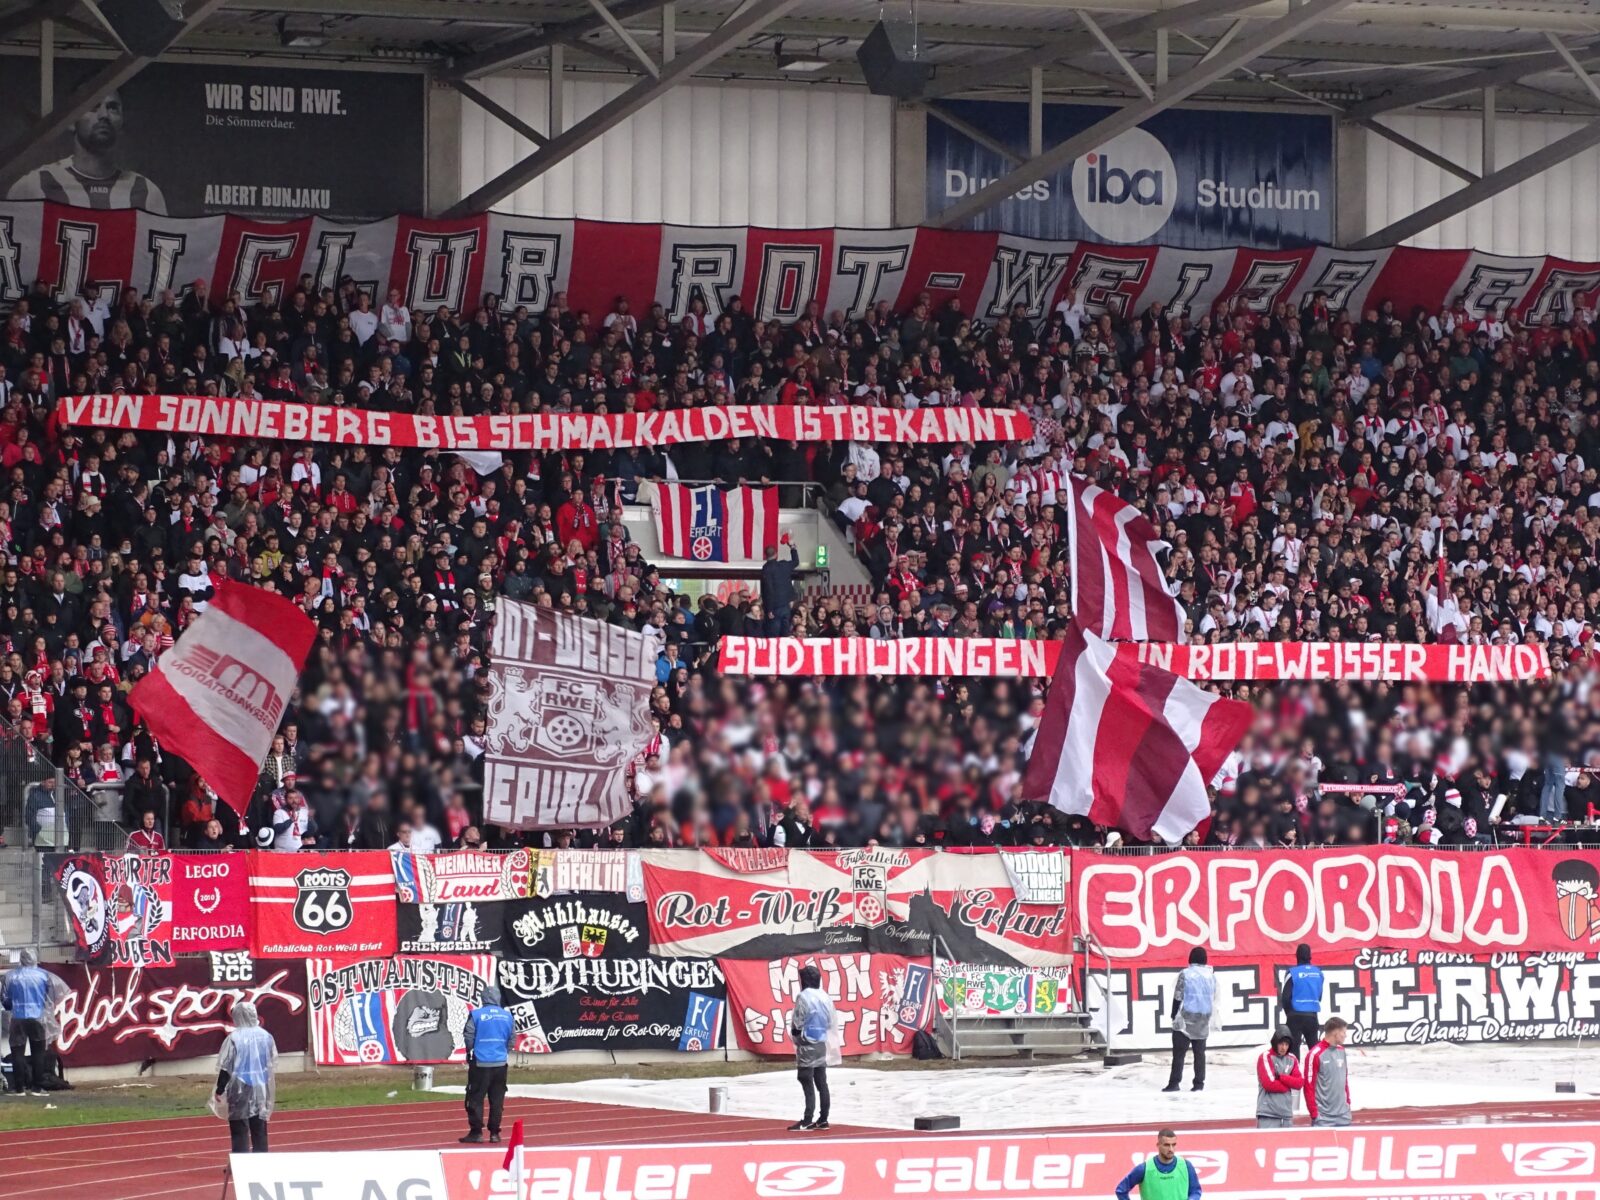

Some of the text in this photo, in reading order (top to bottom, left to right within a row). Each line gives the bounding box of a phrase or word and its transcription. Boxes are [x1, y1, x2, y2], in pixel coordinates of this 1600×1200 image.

[205, 83, 347, 115] WIR SIND RWE.
[205, 114, 296, 130] Die Sömmerdaer.
[1088, 152, 1163, 206] iba
[1198, 178, 1320, 211] Studium
[205, 184, 331, 210] ALBERT BUNJAKU
[66, 395, 143, 427] VON
[156, 395, 392, 446] SONNEBERG
[414, 414, 479, 449] BIS
[489, 405, 779, 450] SCHMALKALDEN
[689, 484, 718, 528] FC
[689, 526, 722, 538] ERFURT
[724, 636, 1047, 677] SÜDTHÜRINGEN
[1187, 640, 1426, 680] ROT-WEISSER
[1447, 643, 1553, 681] HAND!
[555, 681, 584, 695] FC
[545, 692, 593, 711] RWE
[185, 864, 230, 879] LEGIO
[435, 853, 502, 875] WEIMARER
[858, 868, 876, 879] FC
[303, 874, 346, 887] ROOTS
[557, 862, 625, 892] BERLIN
[855, 879, 883, 889] RWE
[438, 878, 500, 900] Land
[302, 891, 348, 928] 66
[959, 889, 1067, 937] Erfurt
[1079, 854, 1529, 958] ERFORDIA
[172, 925, 246, 941] ERFORDIA
[513, 900, 640, 947] Mühlhausen
[110, 939, 173, 965] BUBEN
[262, 944, 313, 953] Fußballclub
[359, 941, 383, 951] Erfurt
[400, 941, 491, 952] GRENZGEBIET
[210, 951, 252, 965] FCK
[1354, 949, 1408, 968] Einst
[213, 965, 252, 982] FCC
[690, 996, 713, 1031] FC
[603, 1027, 618, 1040] für
[684, 1026, 710, 1040] ERFURT
[1353, 1022, 1387, 1042] dem
[1406, 1019, 1467, 1043] Glanz
[1477, 1017, 1543, 1039] Deiner
[1555, 1018, 1600, 1038] alten
[894, 1145, 1106, 1192] saller
[1273, 1143, 1477, 1184] saller
[486, 1156, 712, 1200] saller
